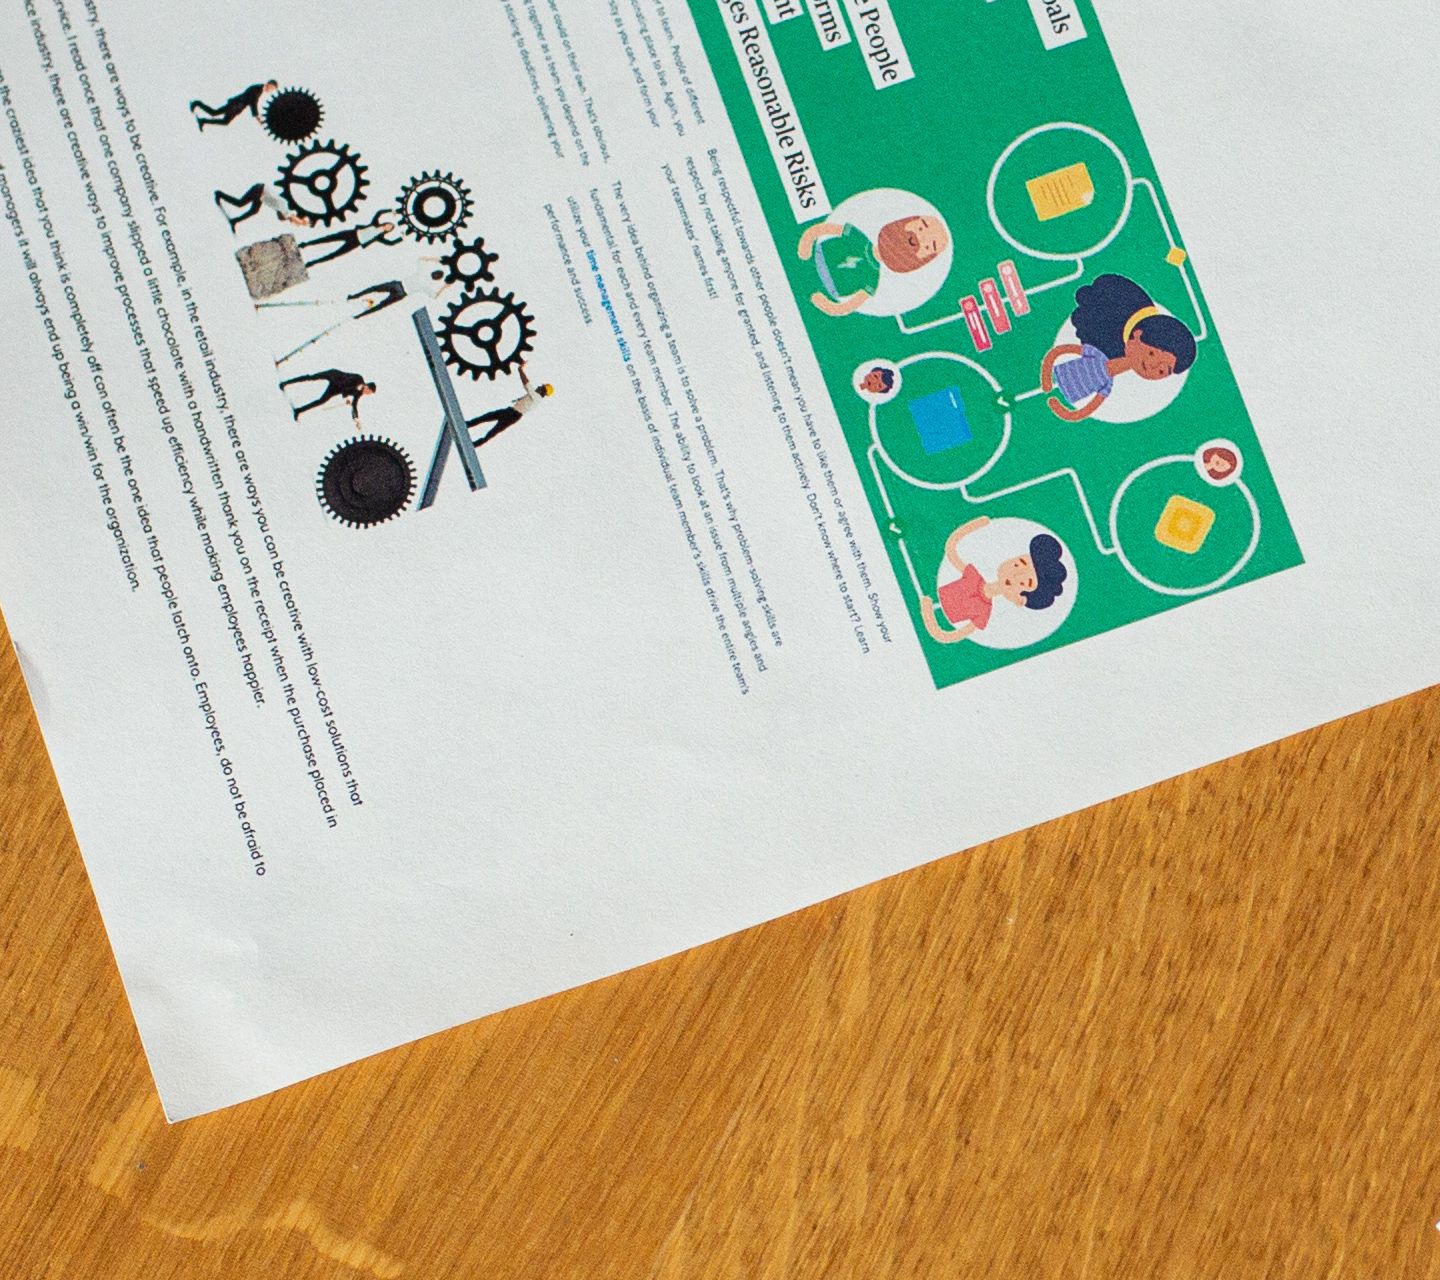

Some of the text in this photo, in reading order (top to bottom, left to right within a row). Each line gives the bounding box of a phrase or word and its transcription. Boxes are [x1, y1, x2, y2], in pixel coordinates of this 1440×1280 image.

[858, 6, 899, 82] People
[737, 24, 796, 149] Reasonable
[783, 149, 817, 209] Risks
[659, 162, 677, 185] your
[690, 243, 709, 277] names
